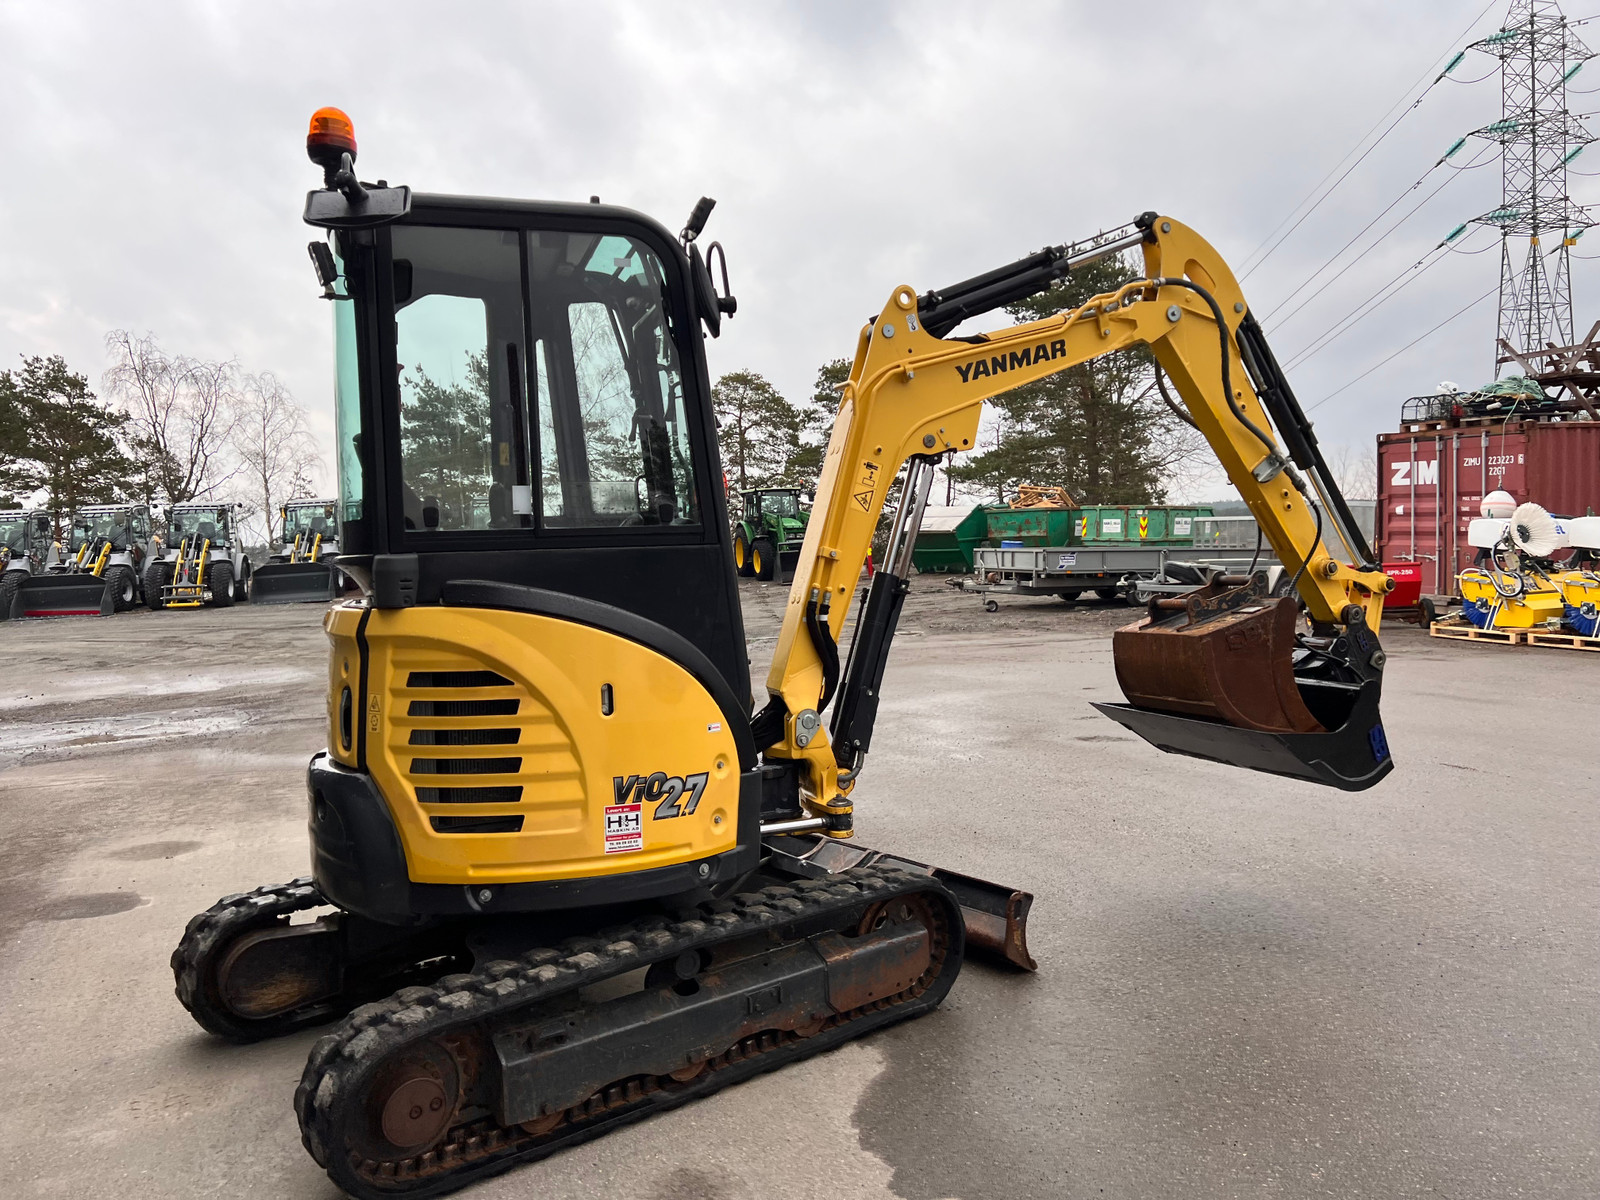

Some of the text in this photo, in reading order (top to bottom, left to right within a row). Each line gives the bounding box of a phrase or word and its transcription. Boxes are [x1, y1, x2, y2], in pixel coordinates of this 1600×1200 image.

[955, 339, 1067, 383] YANMAR
[1463, 456, 1481, 467] ZIMU
[1488, 455, 1514, 465] 223223
[1391, 460, 1439, 486] ZIM
[1488, 466, 1506, 476] 22G1
